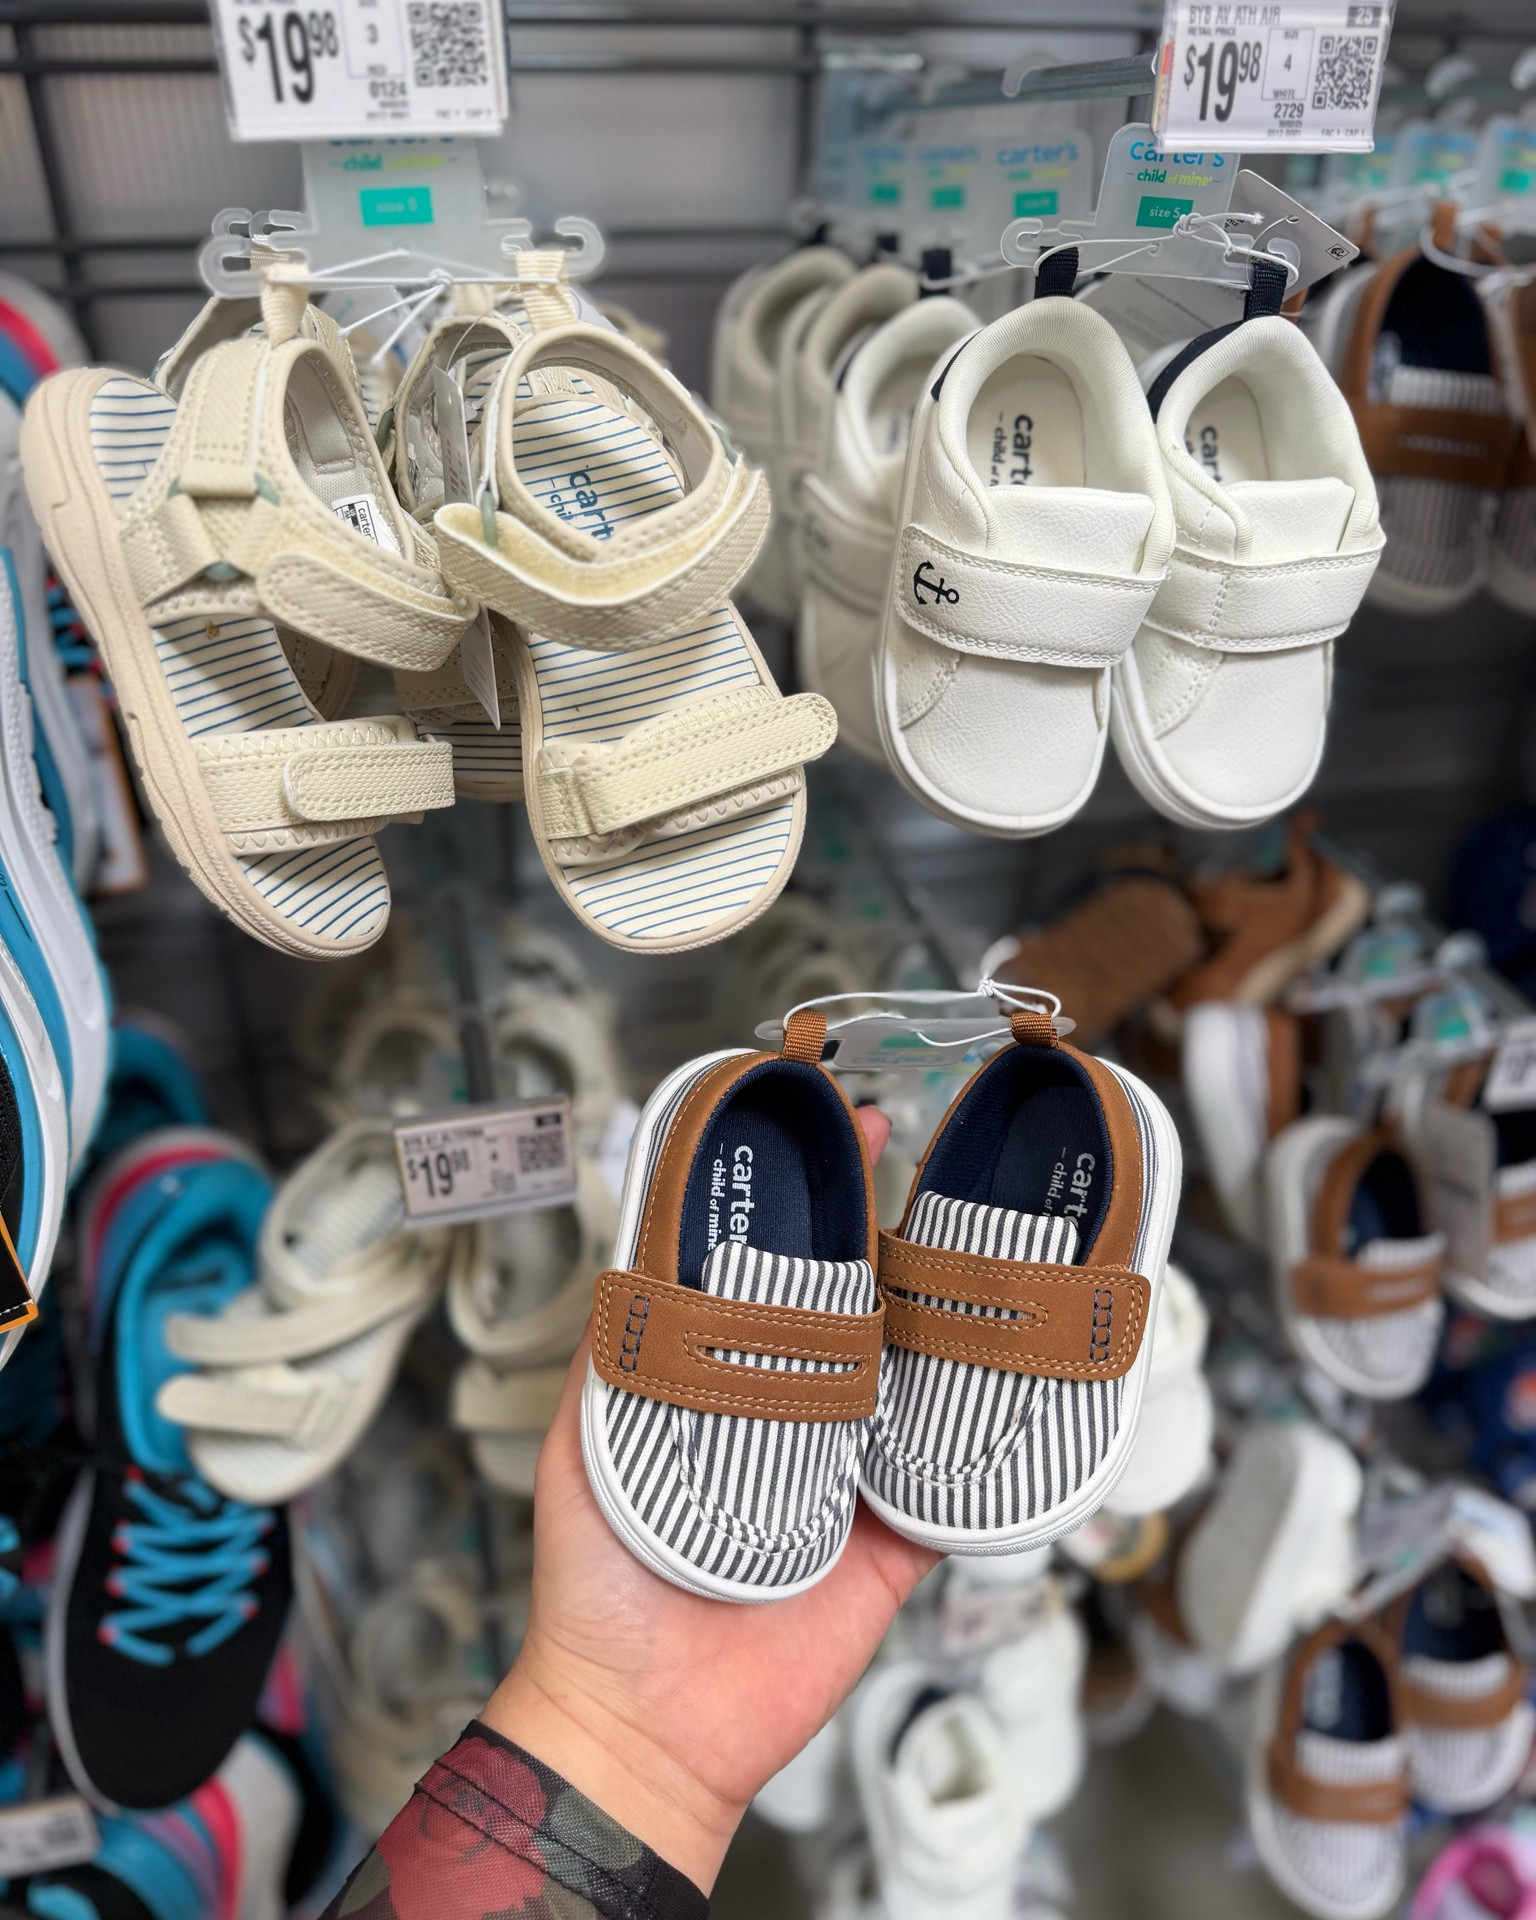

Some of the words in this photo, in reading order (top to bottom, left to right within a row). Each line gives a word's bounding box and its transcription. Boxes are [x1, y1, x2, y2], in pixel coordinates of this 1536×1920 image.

[1189, 6, 1211, 24] BYB
[1215, 6, 1231, 24] AV
[1233, 6, 1257, 25] ATH
[1259, 6, 1281, 25] AIR
[366, 23, 378, 44] 3
[1188, 27, 1212, 36] RETAIL
[1214, 27, 1236, 36] PRICE
[1283, 30, 1299, 40] SIZE
[1284, 54, 1292, 71] 4
[1273, 89, 1296, 99] WHITE
[1274, 103, 1304, 118] 2729
[1137, 168, 1167, 183] child
[1149, 206, 1171, 218] size
[1173, 207, 1181, 218] 5
[992, 427, 1007, 464] child
[1010, 414, 1032, 486] cart
[711, 1159, 727, 1198] child
[1047, 1162, 1068, 1199] child
[709, 1198, 720, 1212] of
[1044, 1199, 1053, 1211] of
